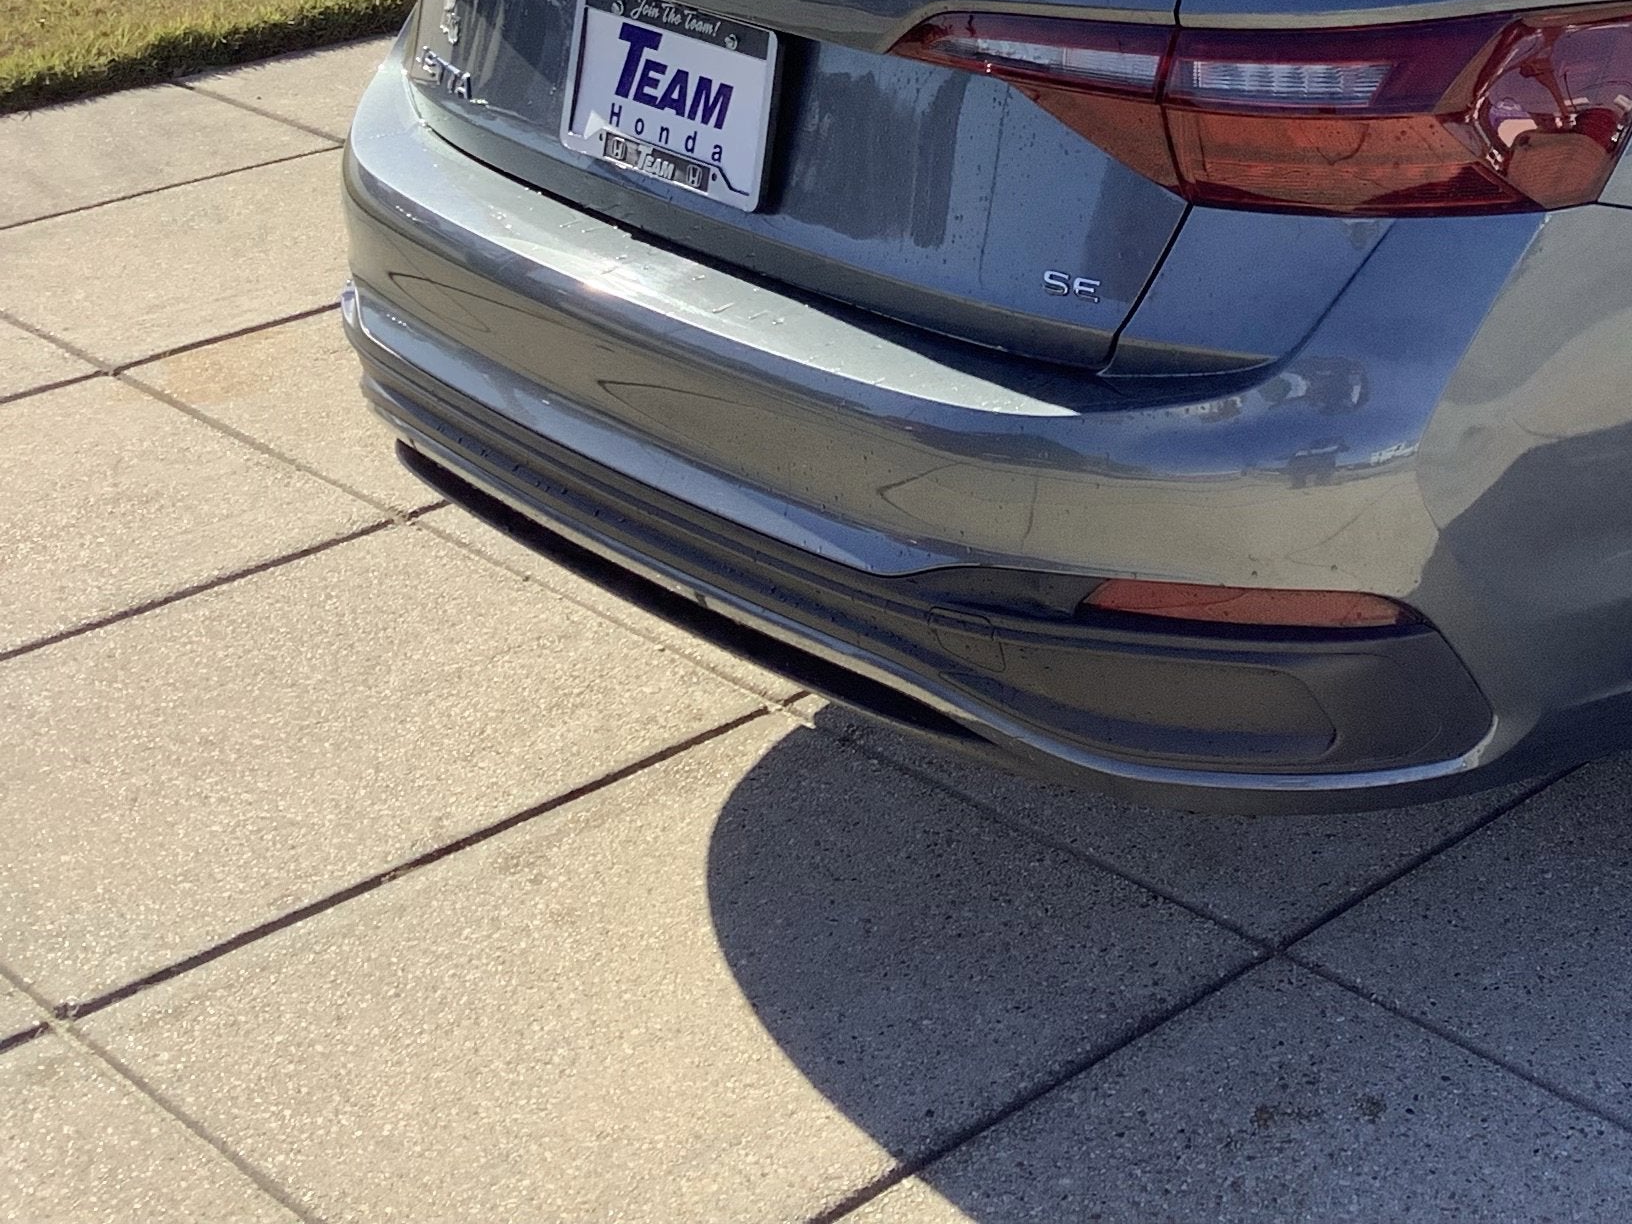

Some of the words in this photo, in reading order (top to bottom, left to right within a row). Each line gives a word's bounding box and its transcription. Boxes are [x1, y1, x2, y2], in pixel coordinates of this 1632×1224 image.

[661, 2, 682, 25] The
[684, 9, 722, 38] Team!
[615, 22, 734, 130] TEAM
[1042, 270, 1100, 303] SE
